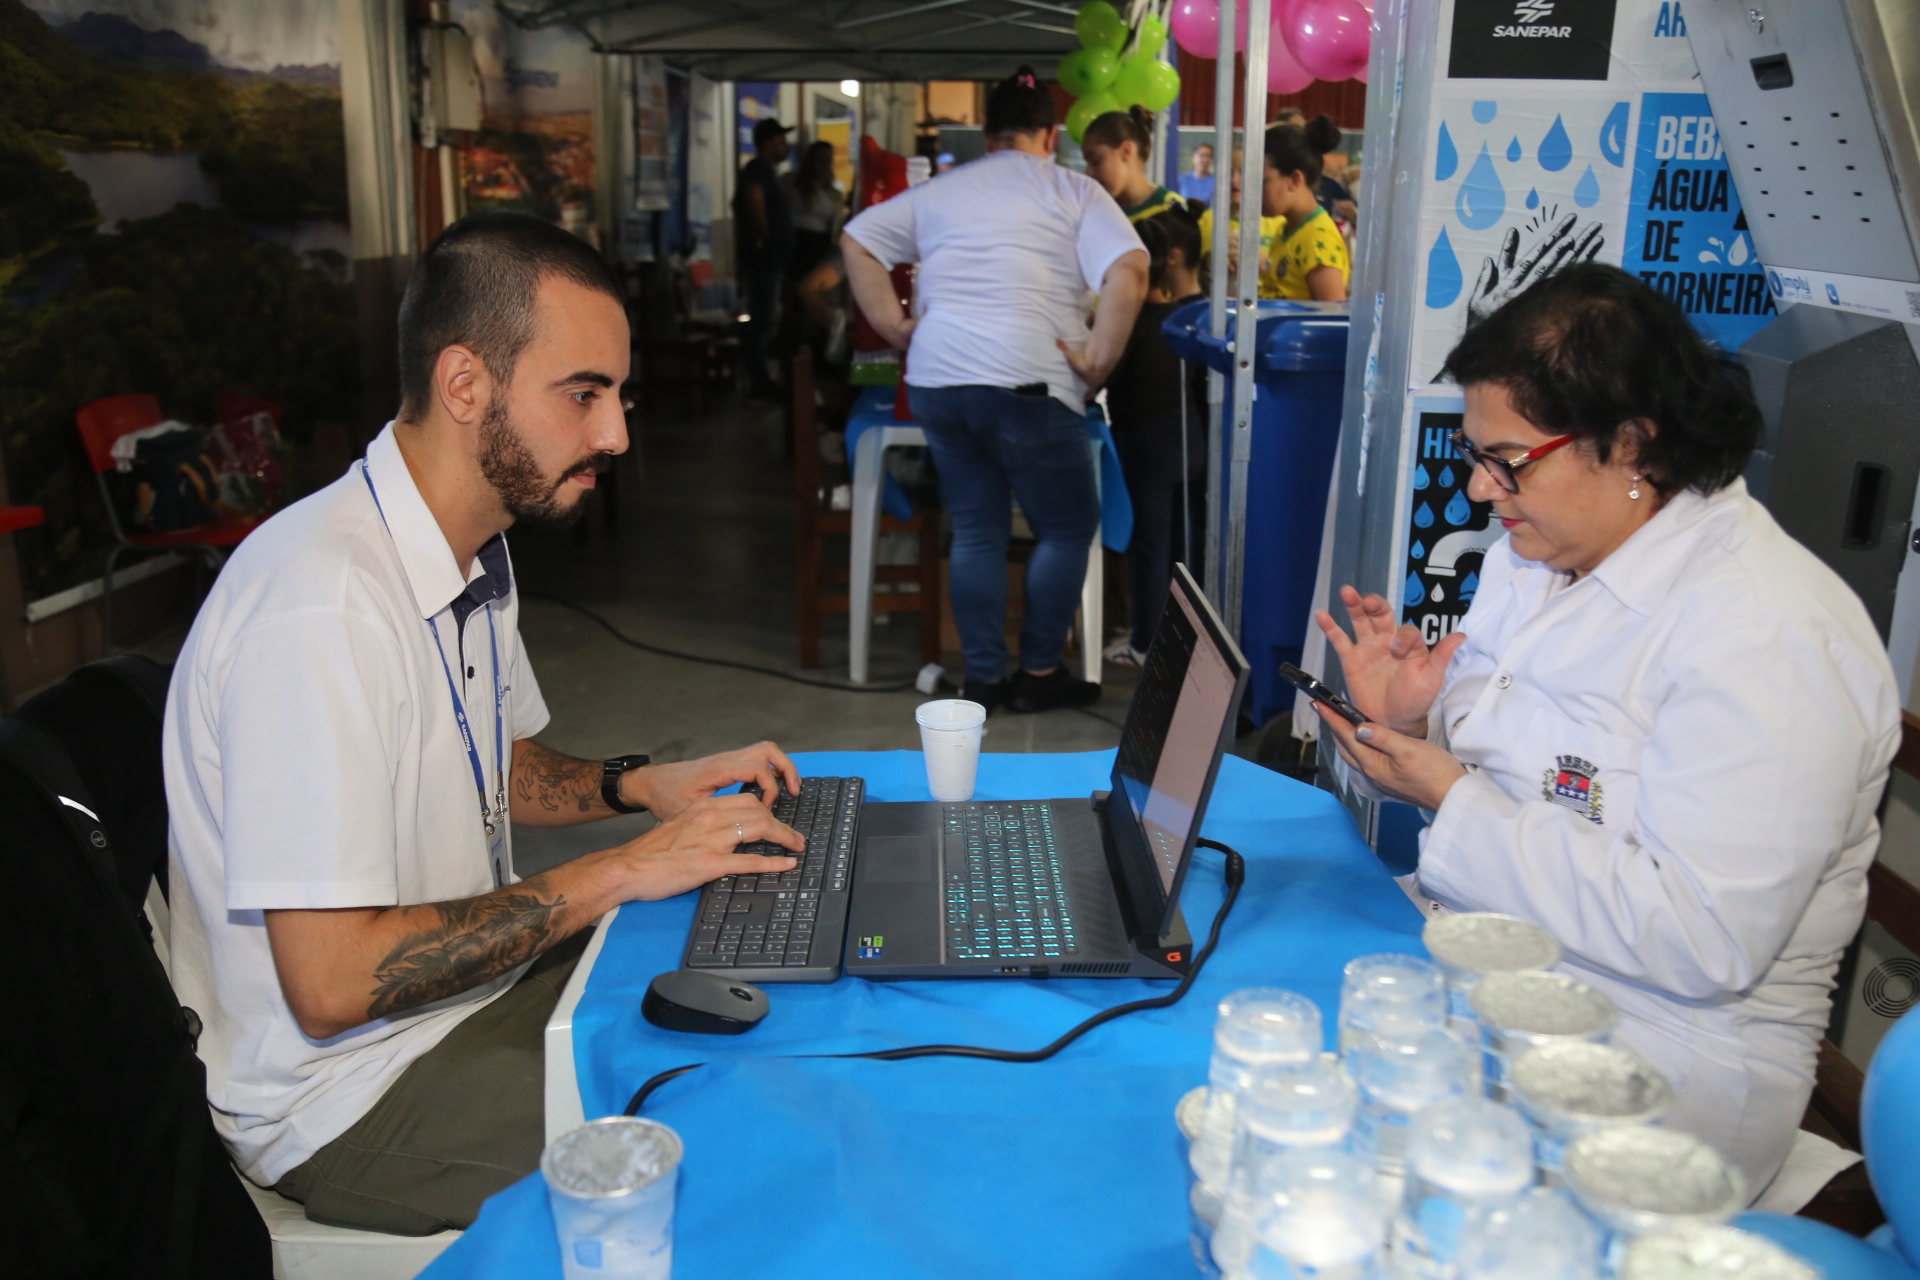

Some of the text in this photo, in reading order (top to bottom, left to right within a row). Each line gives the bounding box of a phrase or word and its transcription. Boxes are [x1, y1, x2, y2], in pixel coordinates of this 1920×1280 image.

[1492, 25, 1572, 38] SANEPAR
[1647, 160, 1729, 212] ÁGUA
[1642, 220, 1684, 262] DE
